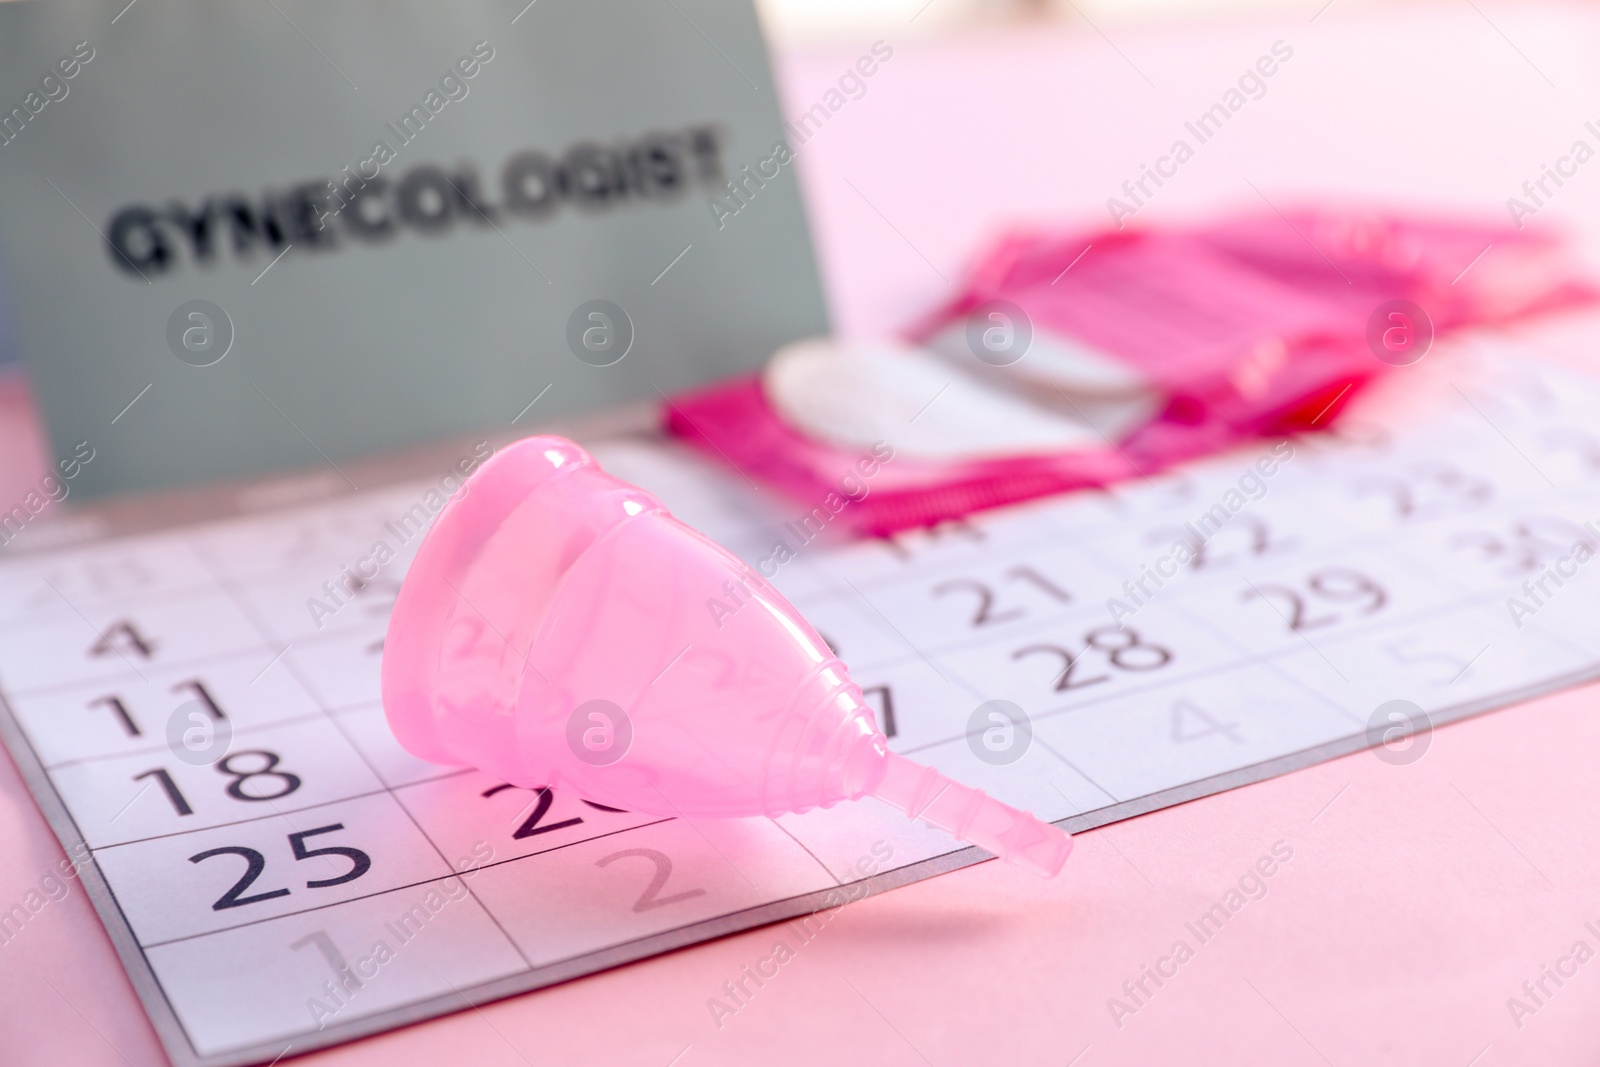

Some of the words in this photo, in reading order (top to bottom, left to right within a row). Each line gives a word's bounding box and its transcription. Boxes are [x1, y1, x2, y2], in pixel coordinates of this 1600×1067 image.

[105, 124, 724, 278] GYNECOLOGIST
[930, 563, 1074, 628] 21
[1238, 566, 1392, 634] 29
[84, 615, 161, 660] 4
[1010, 624, 1174, 692] 28
[86, 679, 227, 738] 11
[1168, 698, 1246, 746] 4
[133, 748, 302, 818] 18
[187, 822, 372, 913] 25
[594, 847, 708, 916] 2
